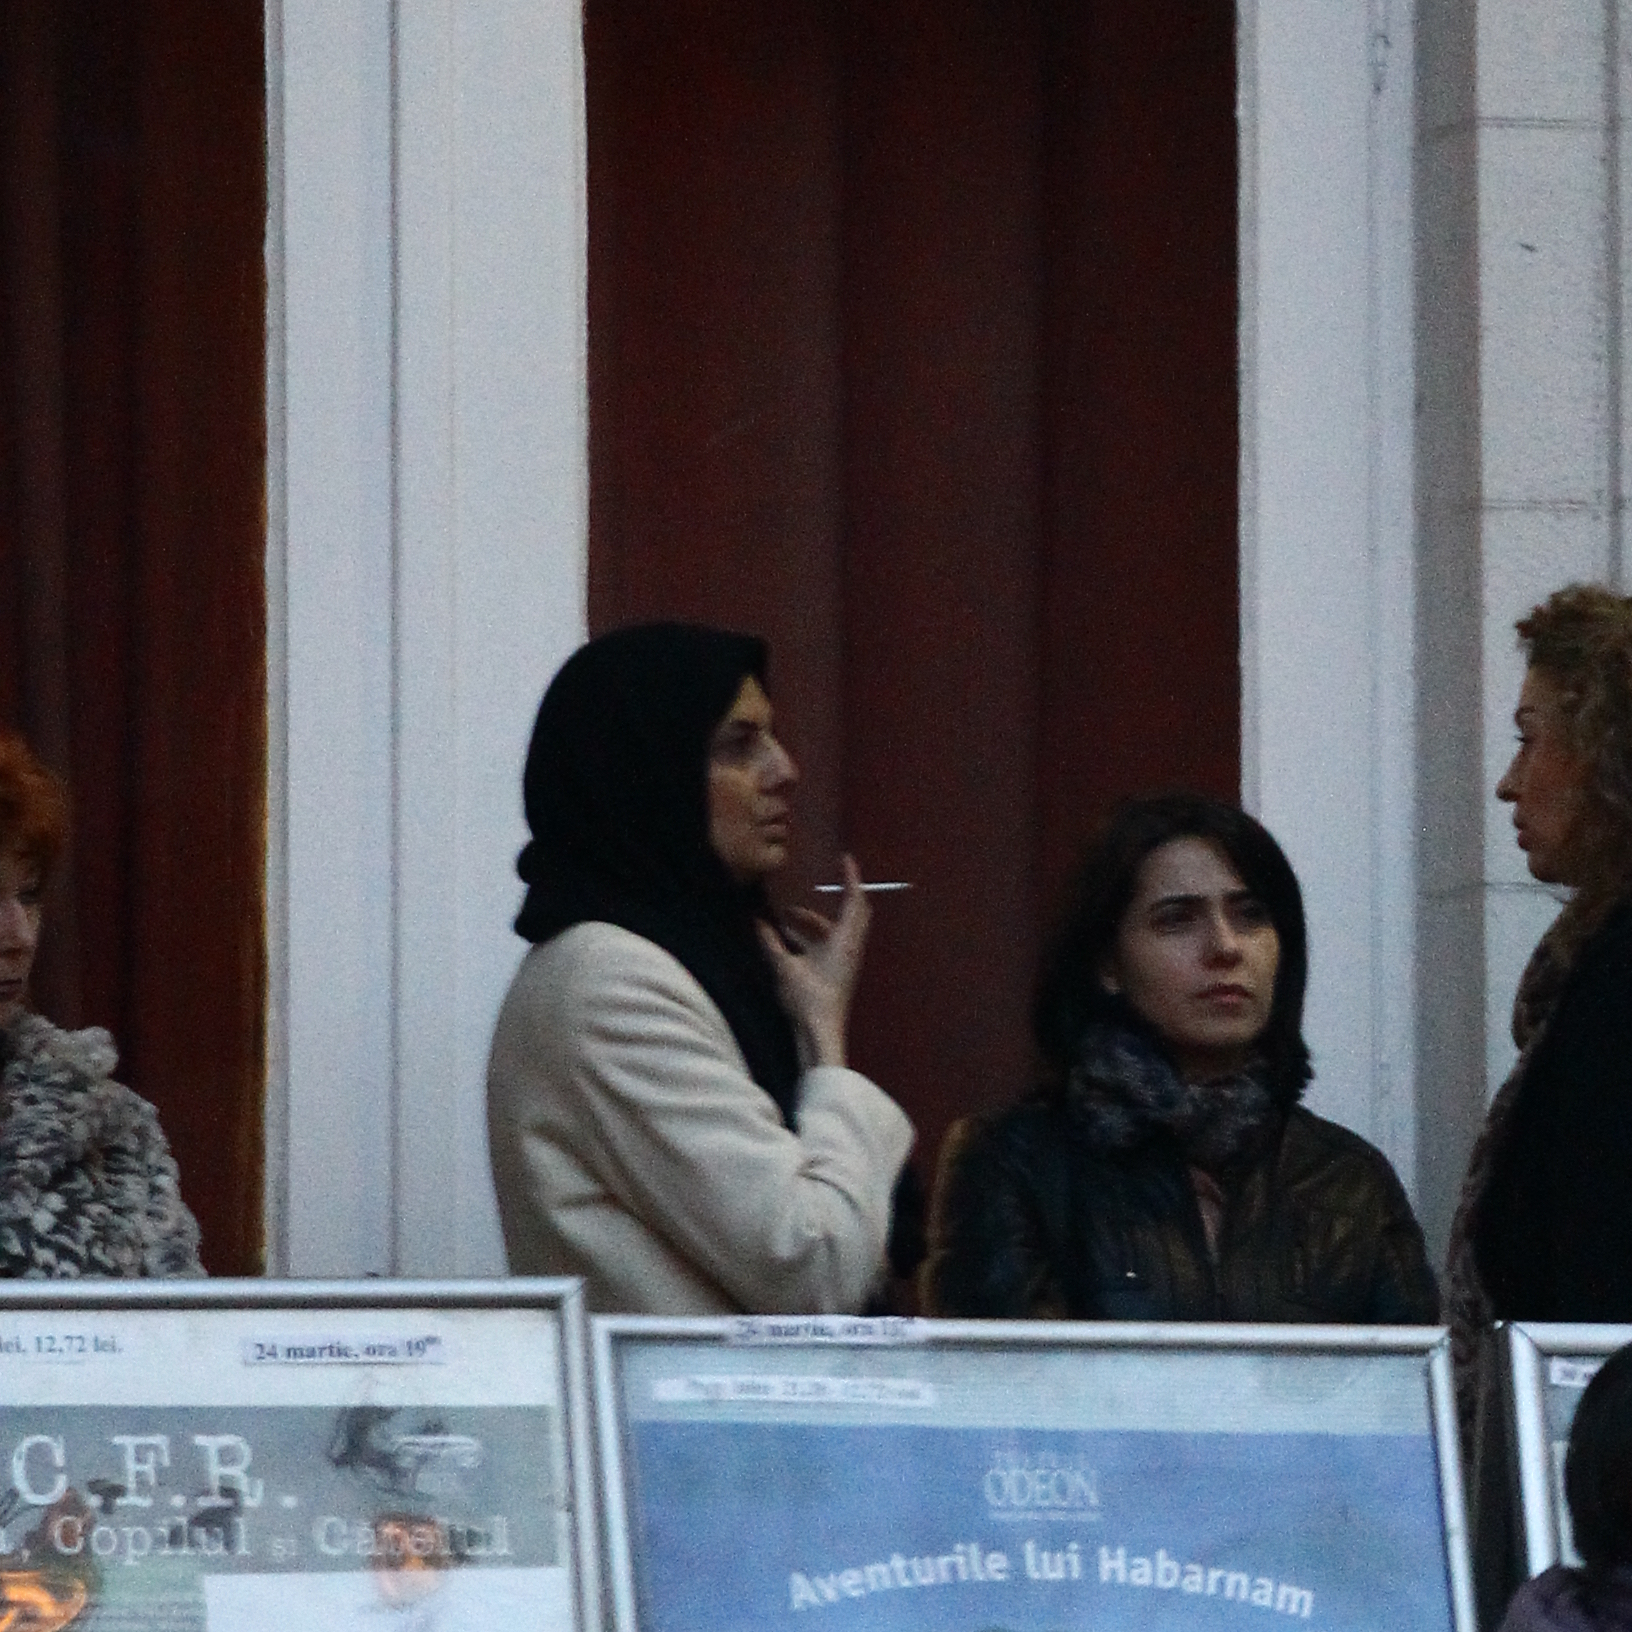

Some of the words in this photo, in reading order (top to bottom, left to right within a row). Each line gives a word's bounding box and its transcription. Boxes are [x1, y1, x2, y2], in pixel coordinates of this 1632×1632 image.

[254, 1342, 278, 1360] 24
[363, 1343, 398, 1357] ora
[984, 1467, 1100, 1508] ODEON
[52, 1515, 254, 1565] Copilul
[790, 1542, 1010, 1611] Aventurile
[1023, 1539, 1080, 1580] lui
[1098, 1545, 1314, 1619] Habarnam
